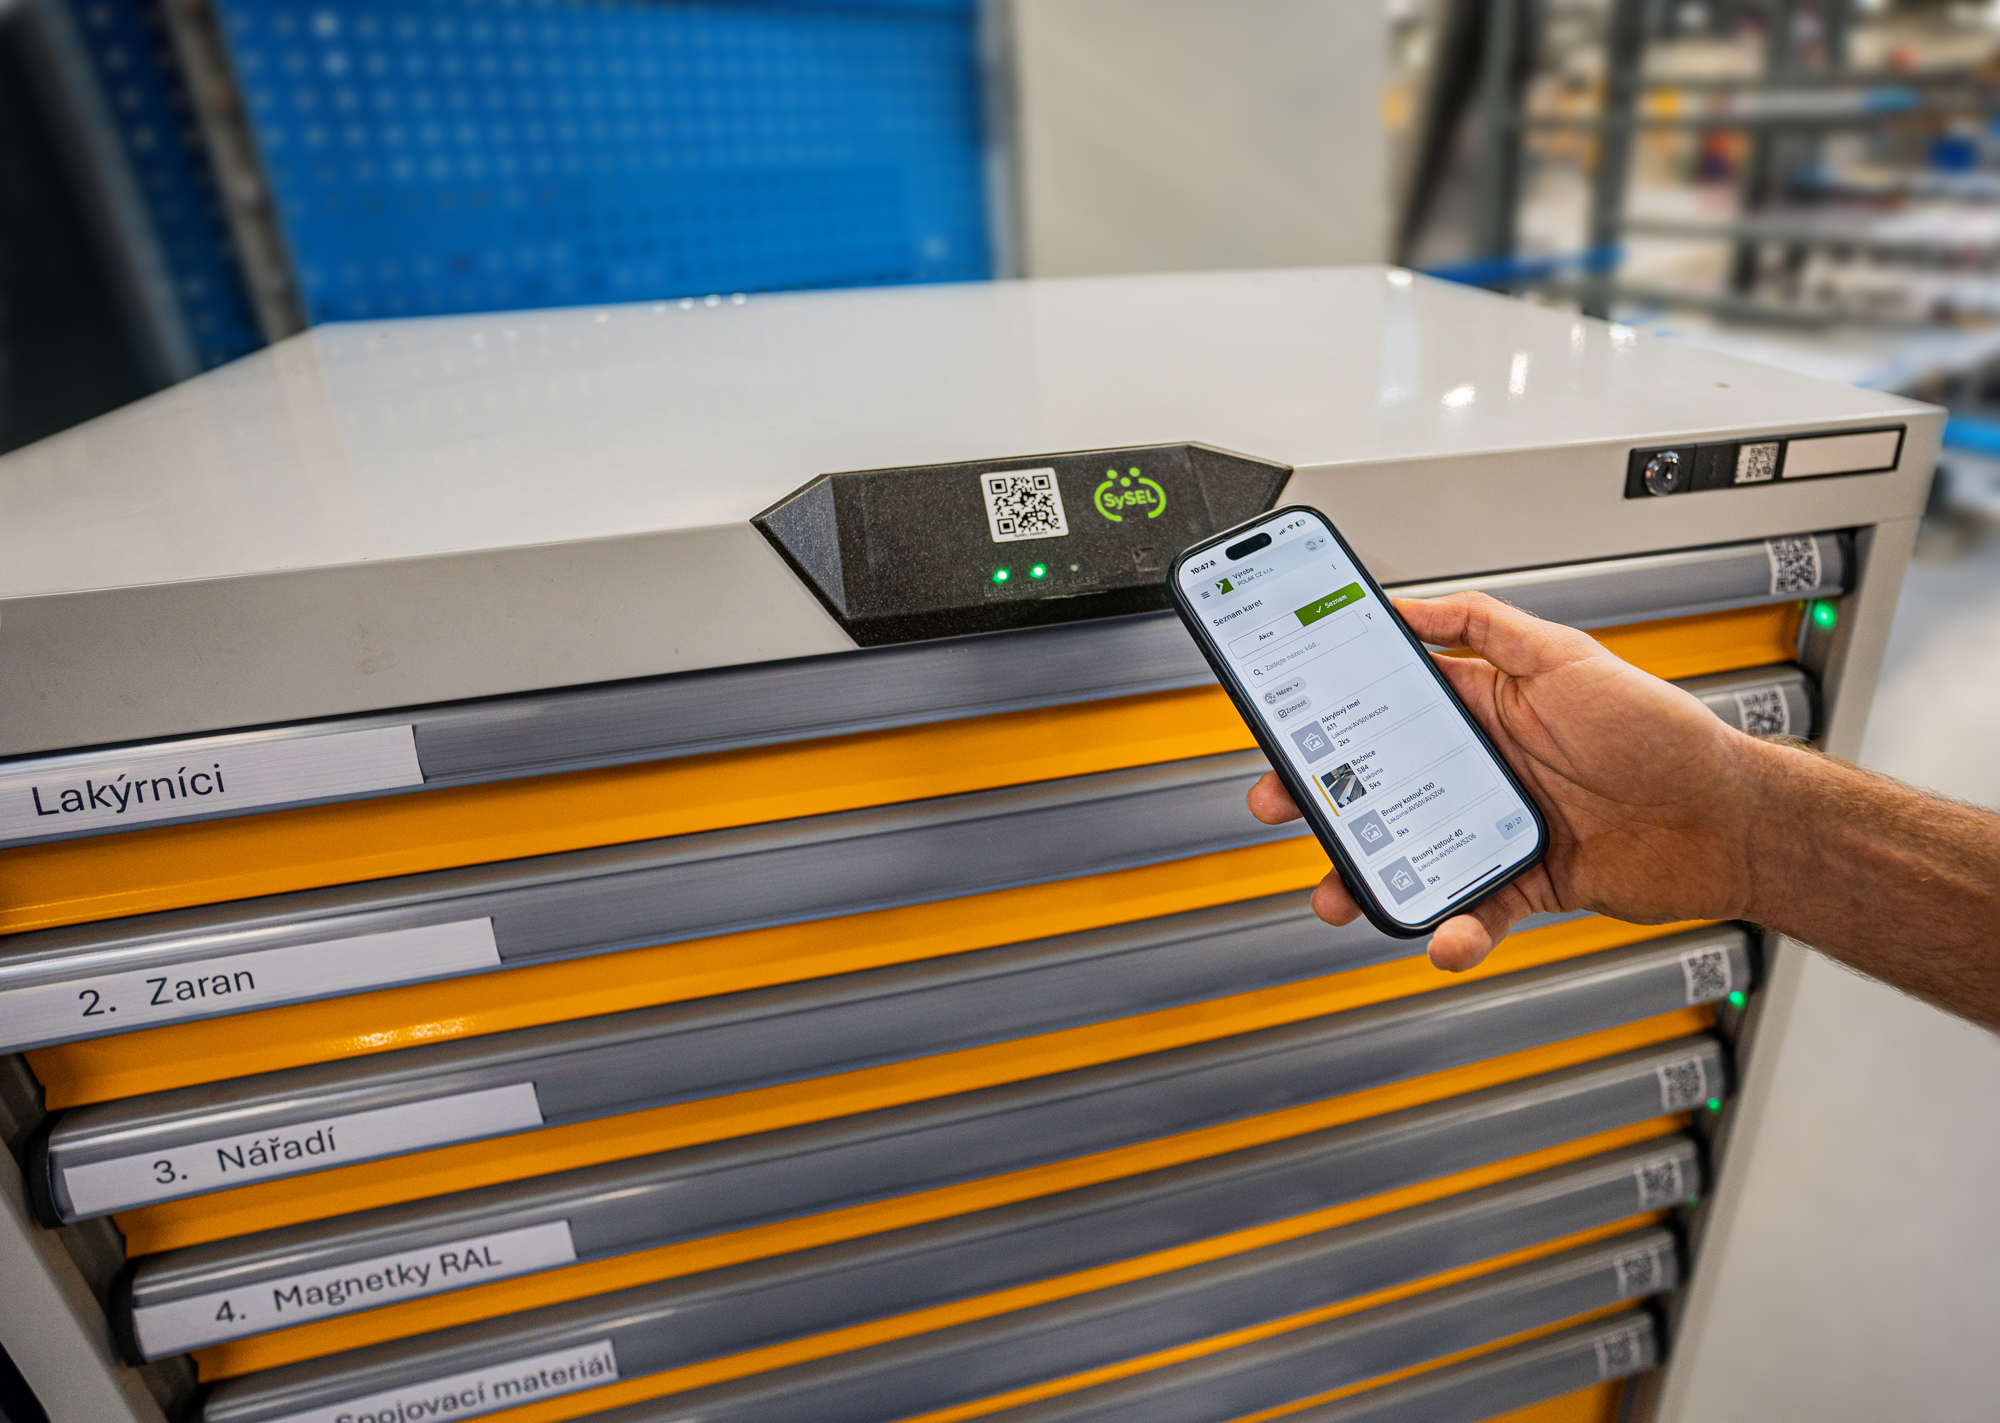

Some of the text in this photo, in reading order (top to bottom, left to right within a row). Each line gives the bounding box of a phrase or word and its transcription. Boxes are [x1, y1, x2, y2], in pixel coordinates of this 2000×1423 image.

[1104, 490, 1156, 509] SySEL
[1190, 562, 1210, 575] 10:47
[1232, 567, 1254, 579] Výroba
[1324, 593, 1348, 609] Seznam
[1213, 599, 1263, 627] Seznam karet
[1258, 630, 1274, 642] Akce
[1265, 657, 1287, 672] Zadejte
[1276, 686, 1292, 697] Název
[1285, 700, 1307, 714] Zobrazit
[1321, 699, 1361, 724] Akrylový tmel
[1326, 722, 1338, 732] AT1
[1338, 738, 1350, 747] 2ks
[1351, 750, 1376, 766] Bočnice
[1357, 764, 1370, 775] 584
[1362, 767, 1384, 782] Lakovna
[32, 763, 225, 816] Lakýrníci
[1369, 779, 1382, 790] 5ks
[1381, 782, 1435, 817] Brusný kotouč 100
[1386, 787, 1446, 825] Lakovna/AVS01/AVSZ06
[1396, 827, 1409, 838] 5ks
[1411, 829, 1464, 864] Brusný kotouč 40
[1417, 833, 1477, 872] Lakovna/AVS01/AVSZ06
[1427, 874, 1440, 885] 5ks
[78, 969, 256, 1017] 2. Zaran
[153, 1126, 336, 1184] 3. Nářadí
[215, 1246, 503, 1324] 4. Magnetky RAL
[493, 1353, 613, 1400] materiál
